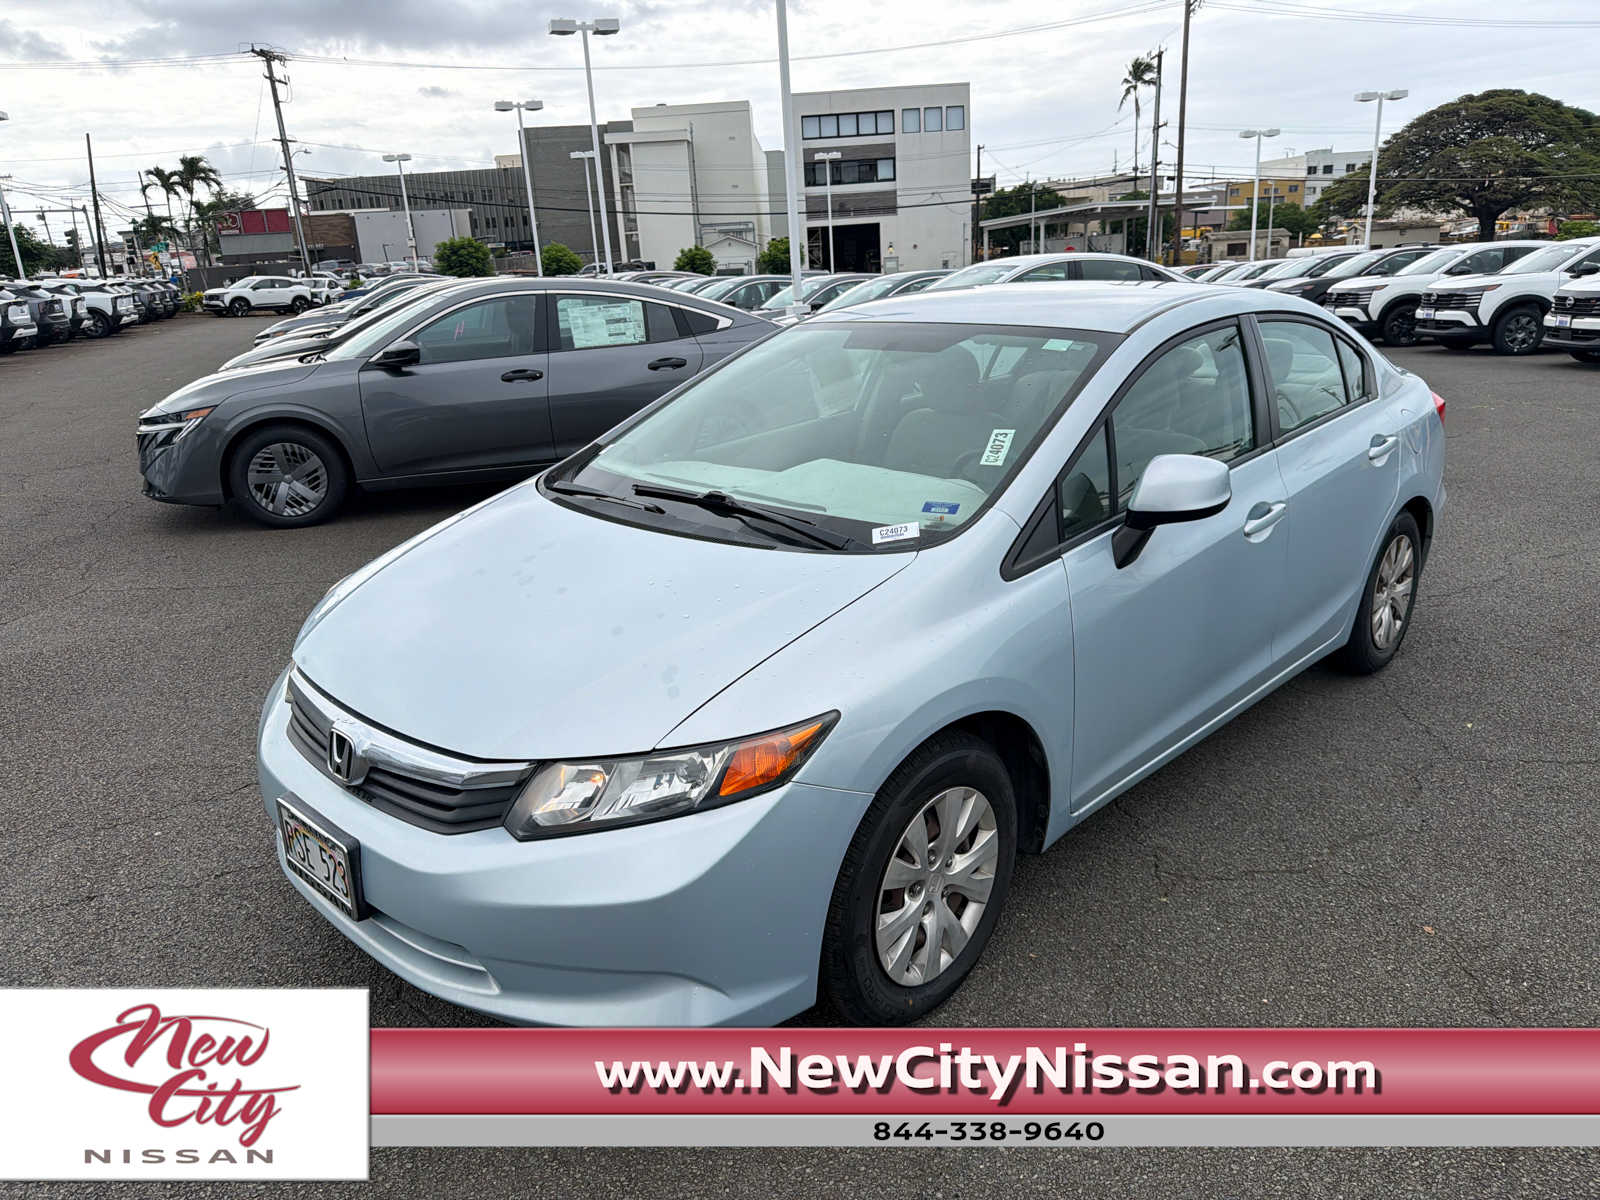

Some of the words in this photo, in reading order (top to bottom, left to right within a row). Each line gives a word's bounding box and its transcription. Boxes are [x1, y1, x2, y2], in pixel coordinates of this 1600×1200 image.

[985, 432, 1009, 463] C24073
[879, 525, 909, 537] C24073
[318, 844, 349, 898] 523
